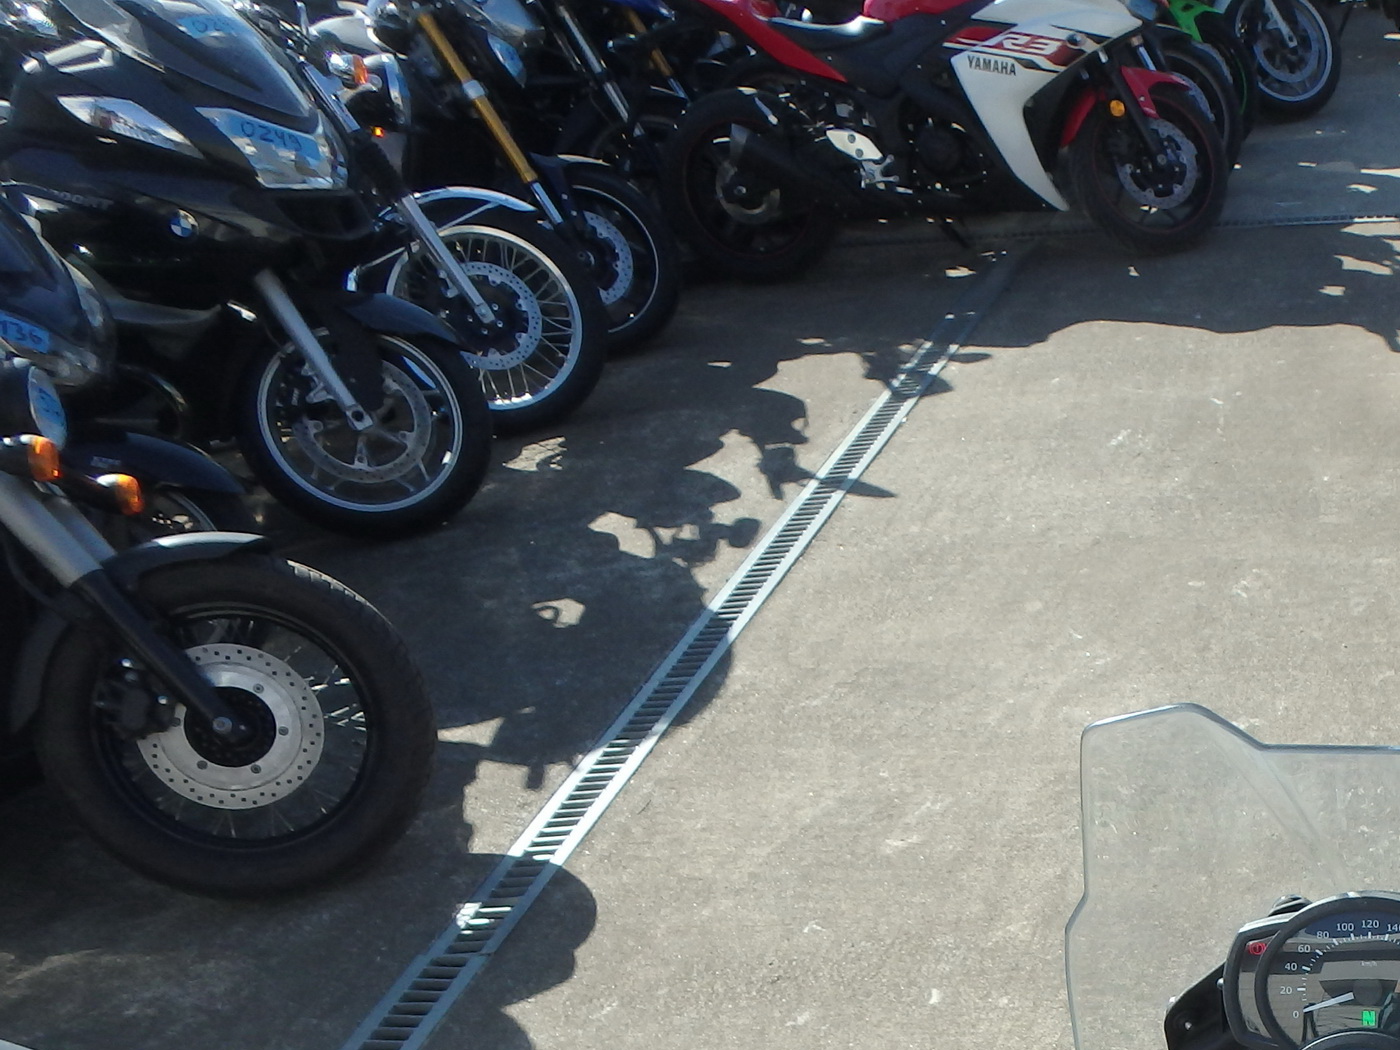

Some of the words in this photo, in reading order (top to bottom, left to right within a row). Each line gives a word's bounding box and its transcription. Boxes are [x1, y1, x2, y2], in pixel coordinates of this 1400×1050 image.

[967, 55, 1017, 76] YAMAHA
[1336, 923, 1355, 932] 100
[1361, 920, 1380, 929] 120
[1316, 931, 1330, 940] 80
[1298, 944, 1311, 953] 60
[1284, 962, 1298, 971] 40
[1280, 986, 1293, 995] 20
[1292, 1011, 1299, 1019] 0
[1361, 1010, 1376, 1026] N
